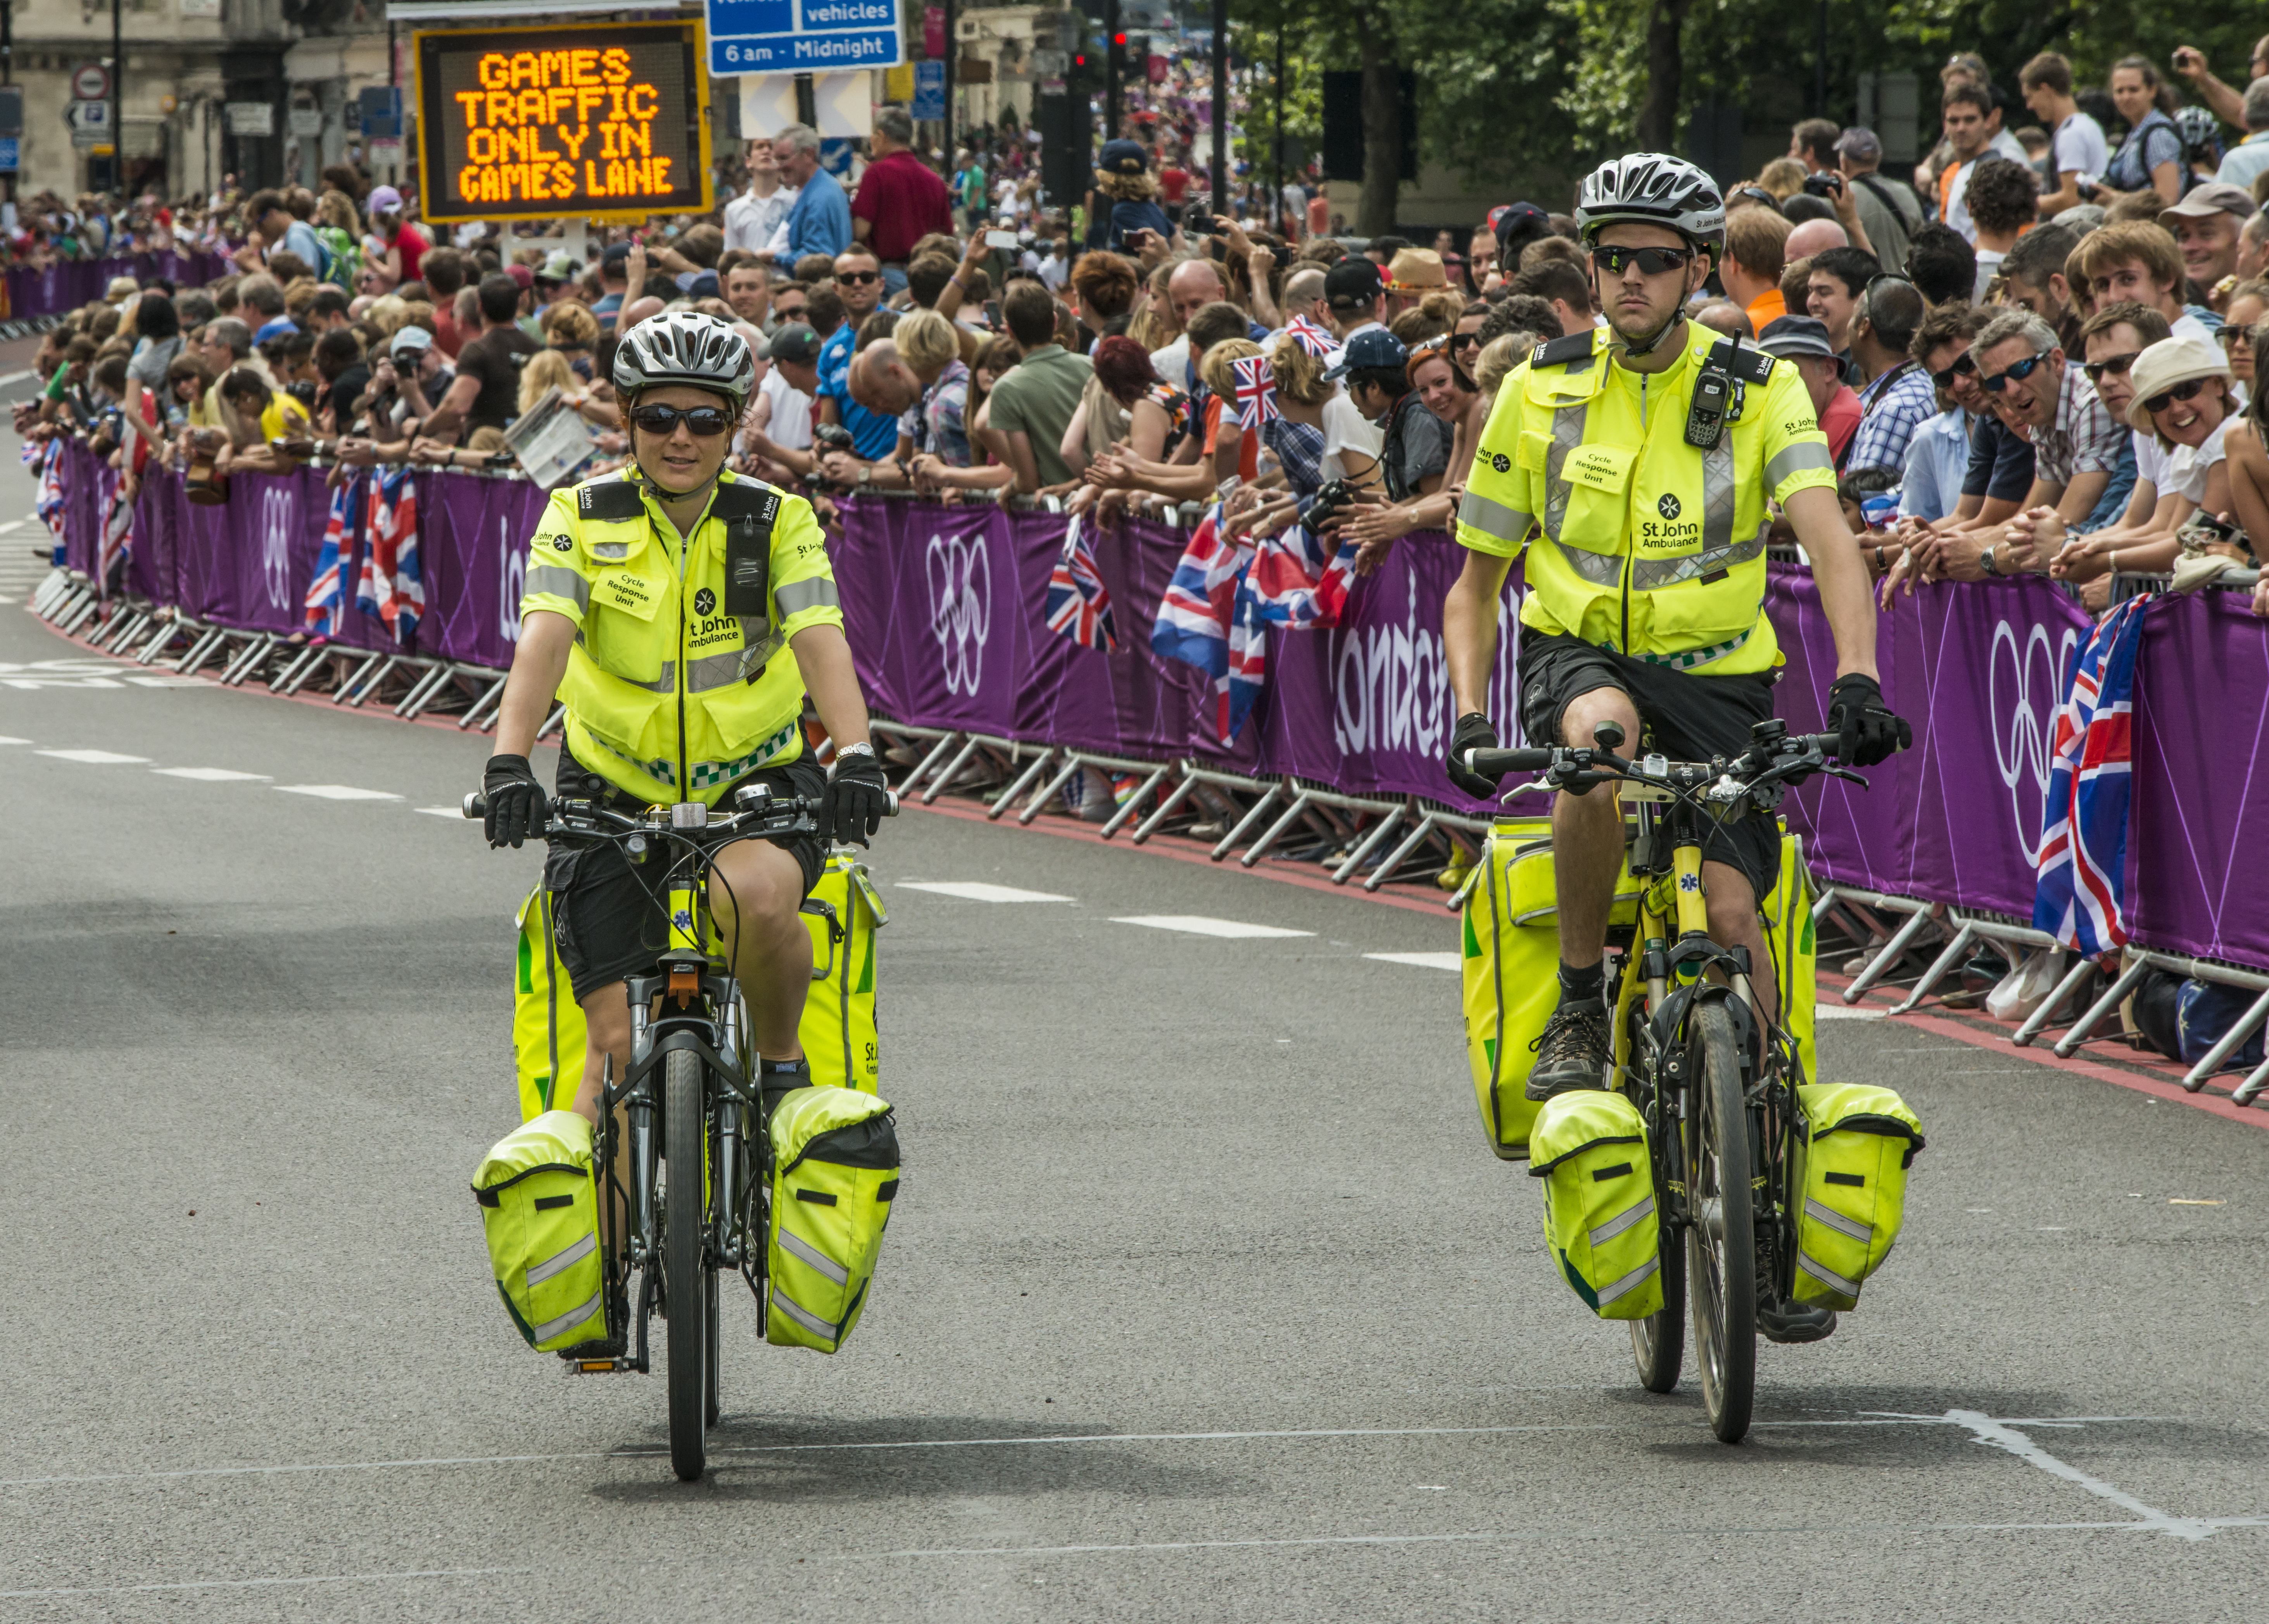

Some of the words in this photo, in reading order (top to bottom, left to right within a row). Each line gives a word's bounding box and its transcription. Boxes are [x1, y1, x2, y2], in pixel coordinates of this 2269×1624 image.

[807, 2, 888, 22] vehicles
[725, 45, 739, 62] 6
[743, 47, 773, 61] am
[794, 37, 884, 58] Midnight
[479, 48, 632, 89] GAMES
[456, 83, 658, 128] TRAFFIC
[468, 123, 589, 164] ONLY
[598, 120, 651, 159] IN
[459, 160, 577, 202] GAMES
[585, 157, 673, 197] LANE
[1538, 348, 1546, 360] John
[1759, 357, 1769, 369] John
[1785, 422, 1796, 431] St
[1478, 446, 1492, 458] ohn
[1589, 454, 1611, 464] Cycle
[1576, 460, 1617, 476] Response
[1585, 473, 1603, 484] Unit
[764, 496, 774, 512] John
[768, 498, 779, 521] Ambulance
[537, 531, 553, 540] John
[1642, 522, 1659, 537] St
[1662, 522, 1697, 537] John
[797, 545, 808, 554] St
[1642, 536, 1698, 548] Ambulance
[621, 575, 644, 588] Cycle
[607, 580, 649, 602] Response
[615, 594, 634, 607] Unit
[700, 616, 736, 635] John
[865, 1042, 874, 1061] St
